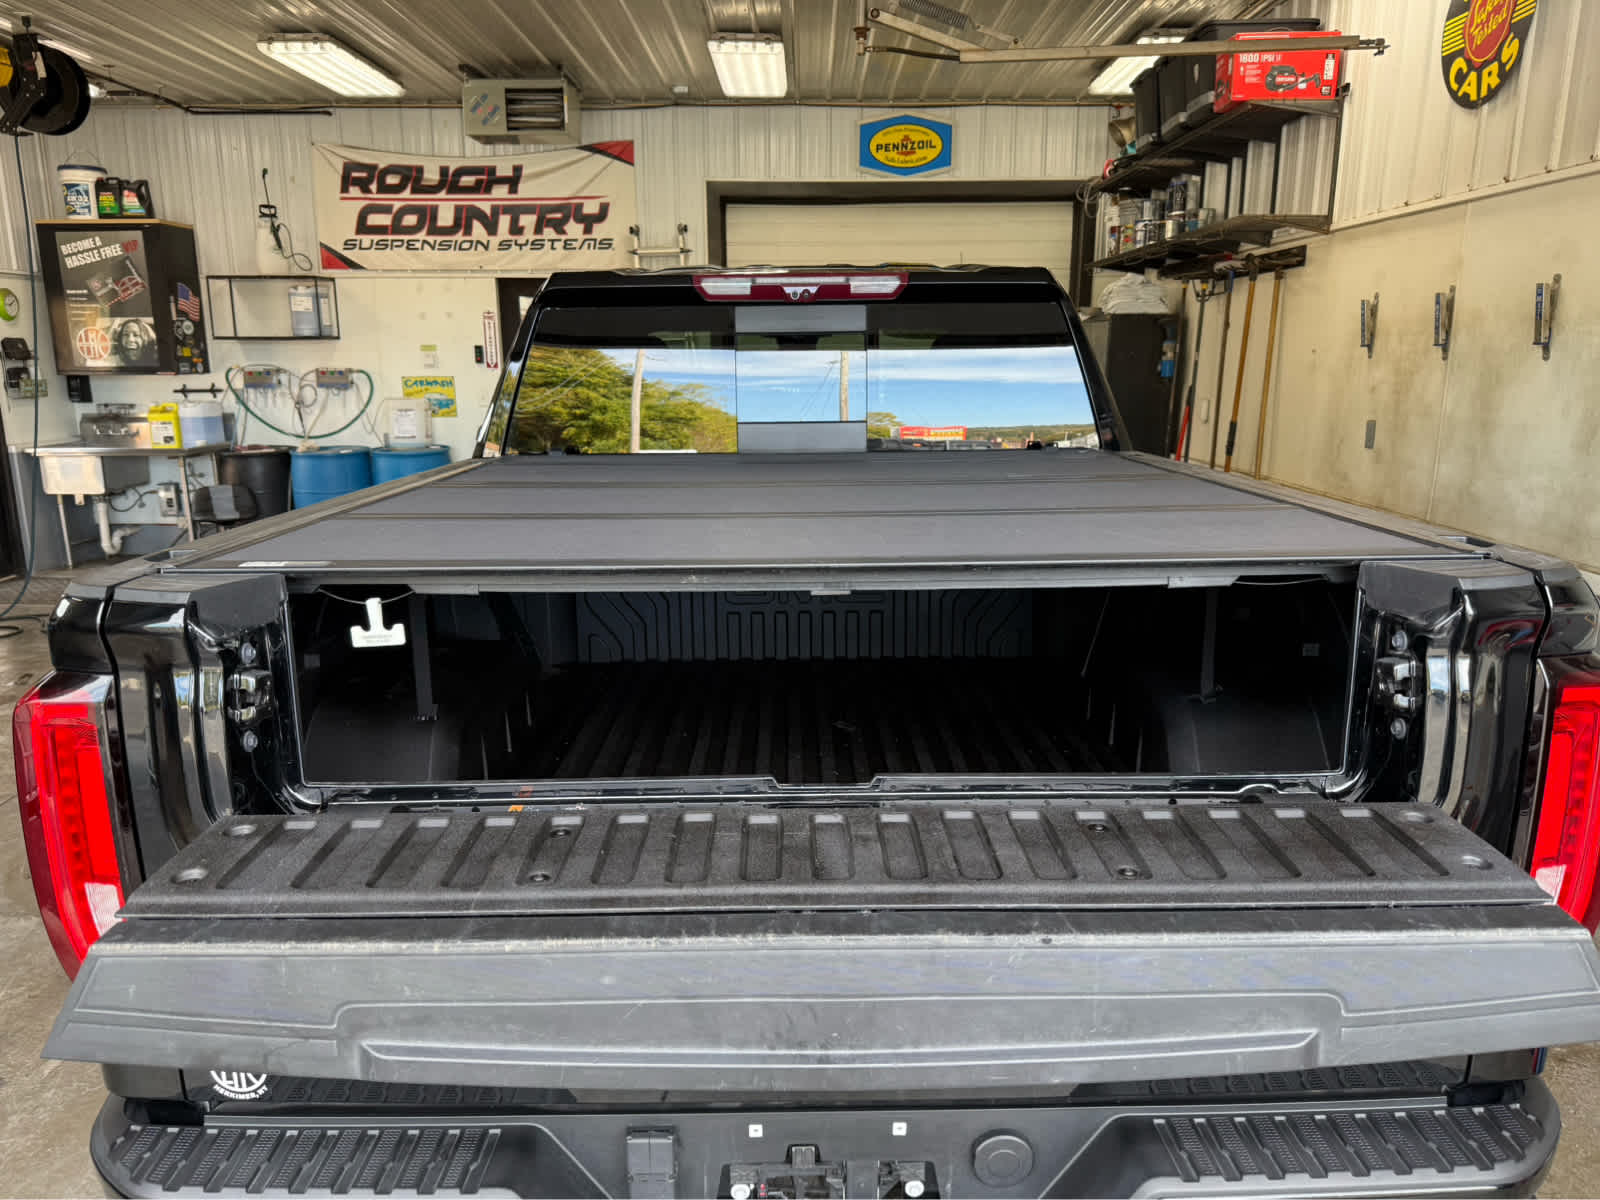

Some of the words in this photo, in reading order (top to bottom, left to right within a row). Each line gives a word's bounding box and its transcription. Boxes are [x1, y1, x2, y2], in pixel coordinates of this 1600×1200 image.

[1449, 31, 1520, 102] CARS
[875, 139, 937, 153] PENNZOIL
[340, 161, 523, 195] ROUGH
[355, 202, 610, 237] COUNTRY
[60, 238, 96, 255] BECOME
[94, 236, 102, 247] A
[64, 249, 101, 269] HASSLE
[100, 243, 124, 260] FREE
[121, 239, 139, 253] VIP
[342, 238, 490, 251] SUSPENSION
